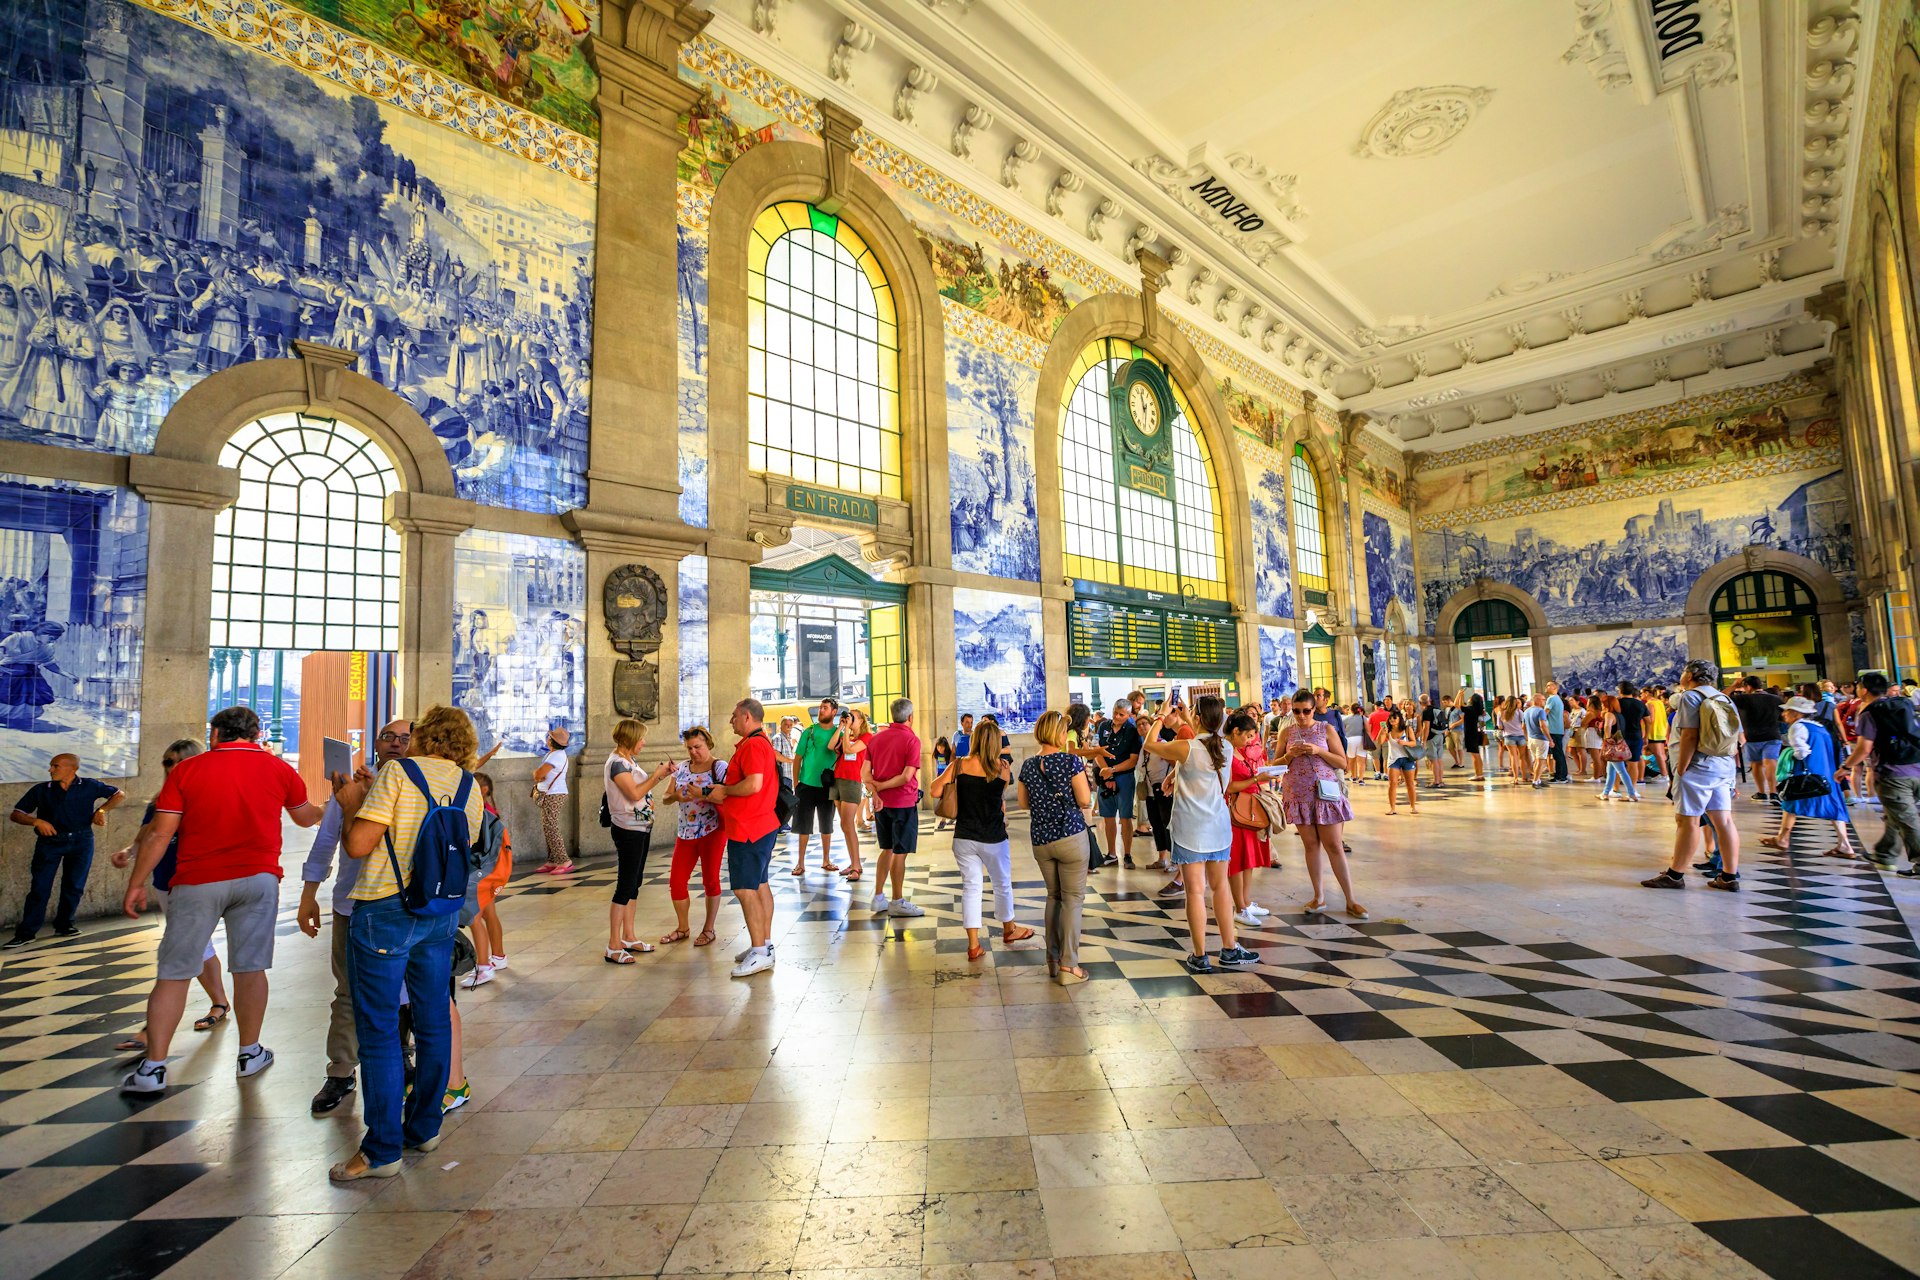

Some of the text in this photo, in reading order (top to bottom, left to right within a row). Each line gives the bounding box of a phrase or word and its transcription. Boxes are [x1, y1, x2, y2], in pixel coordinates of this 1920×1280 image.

[1651, 0, 1703, 61] DOV
[1190, 176, 1264, 232] MINHO
[1136, 471, 1161, 488] PORTO
[794, 489, 871, 519] ENTRADA
